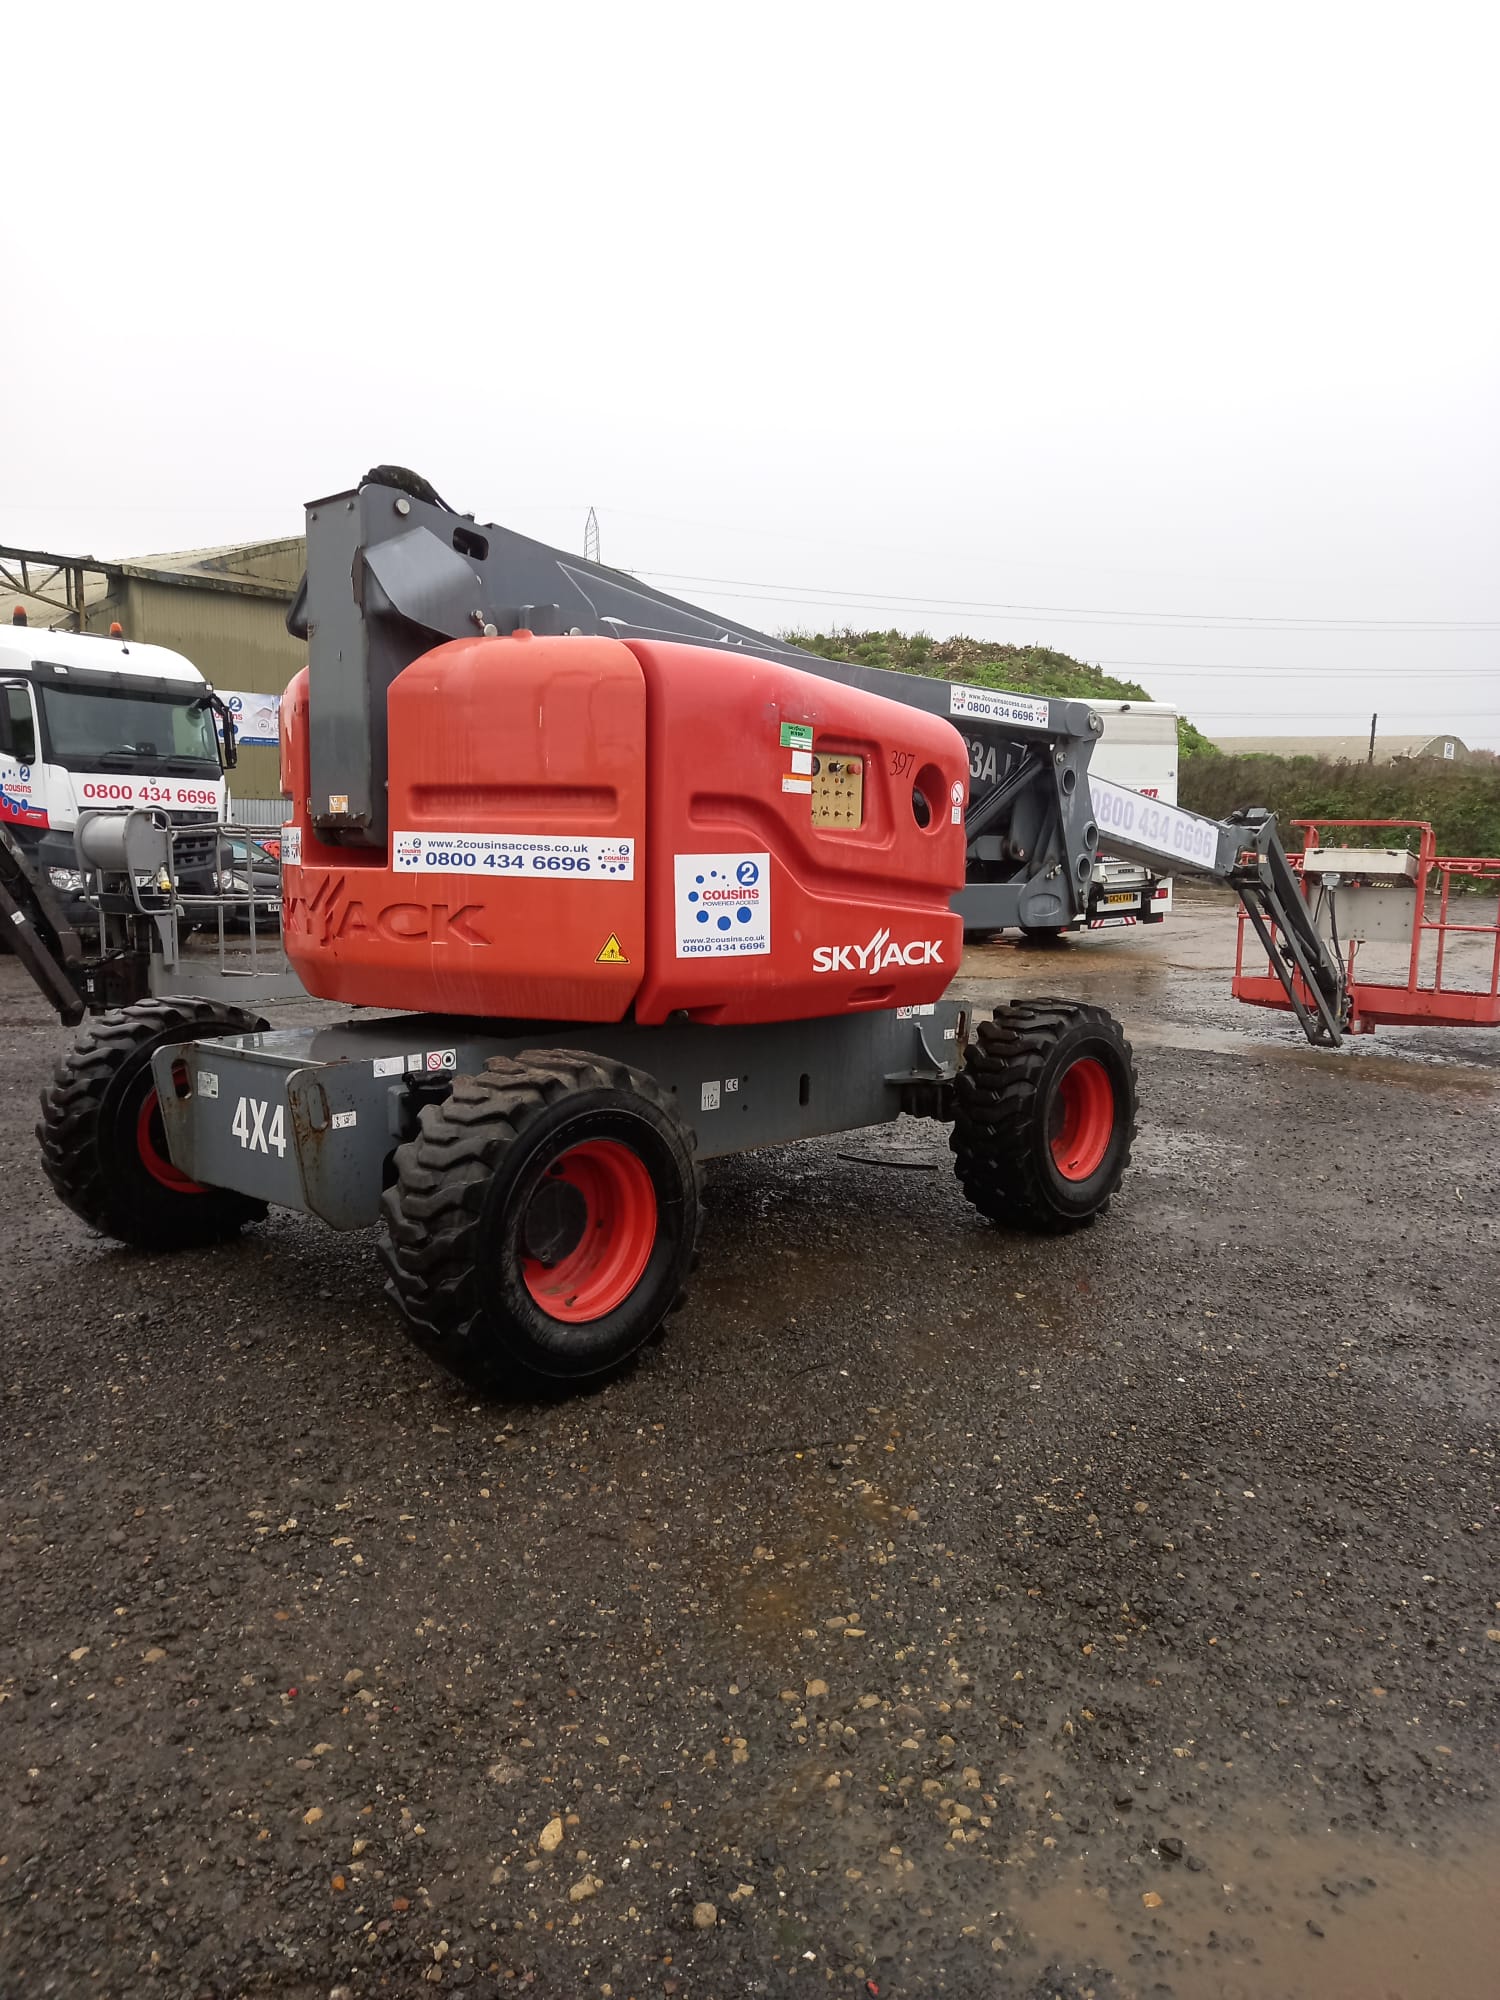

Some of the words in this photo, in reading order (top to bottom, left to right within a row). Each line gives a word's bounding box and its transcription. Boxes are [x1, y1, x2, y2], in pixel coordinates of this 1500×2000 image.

[231, 698, 240, 710] 2
[967, 701, 990, 714] 0800
[993, 706, 1010, 717] 434
[1012, 709, 1034, 722] 6696
[21, 766, 28, 780] 2
[890, 750, 915, 779] 397
[4, 783, 32, 793] cousins
[83, 783, 133, 800] 0800
[138, 786, 172, 802] 434
[177, 789, 217, 805] 6696
[1092, 787, 1135, 831] 0800
[1138, 807, 1170, 843] 434
[1174, 820, 1213, 859] 6696
[428, 838, 588, 854] www.2cousinsaccess.co.uk
[425, 852, 477, 867] 0800
[483, 854, 525, 869] 434
[532, 856, 591, 872] 6696
[741, 863, 755, 882] 2
[702, 886, 759, 900] cousins
[682, 934, 765, 944] www.2cousins.co.uk
[682, 944, 712, 953] 0800
[739, 942, 765, 950] 6696
[813, 927, 944, 975] SKYJACK
[231, 1096, 287, 1158] 4X4
